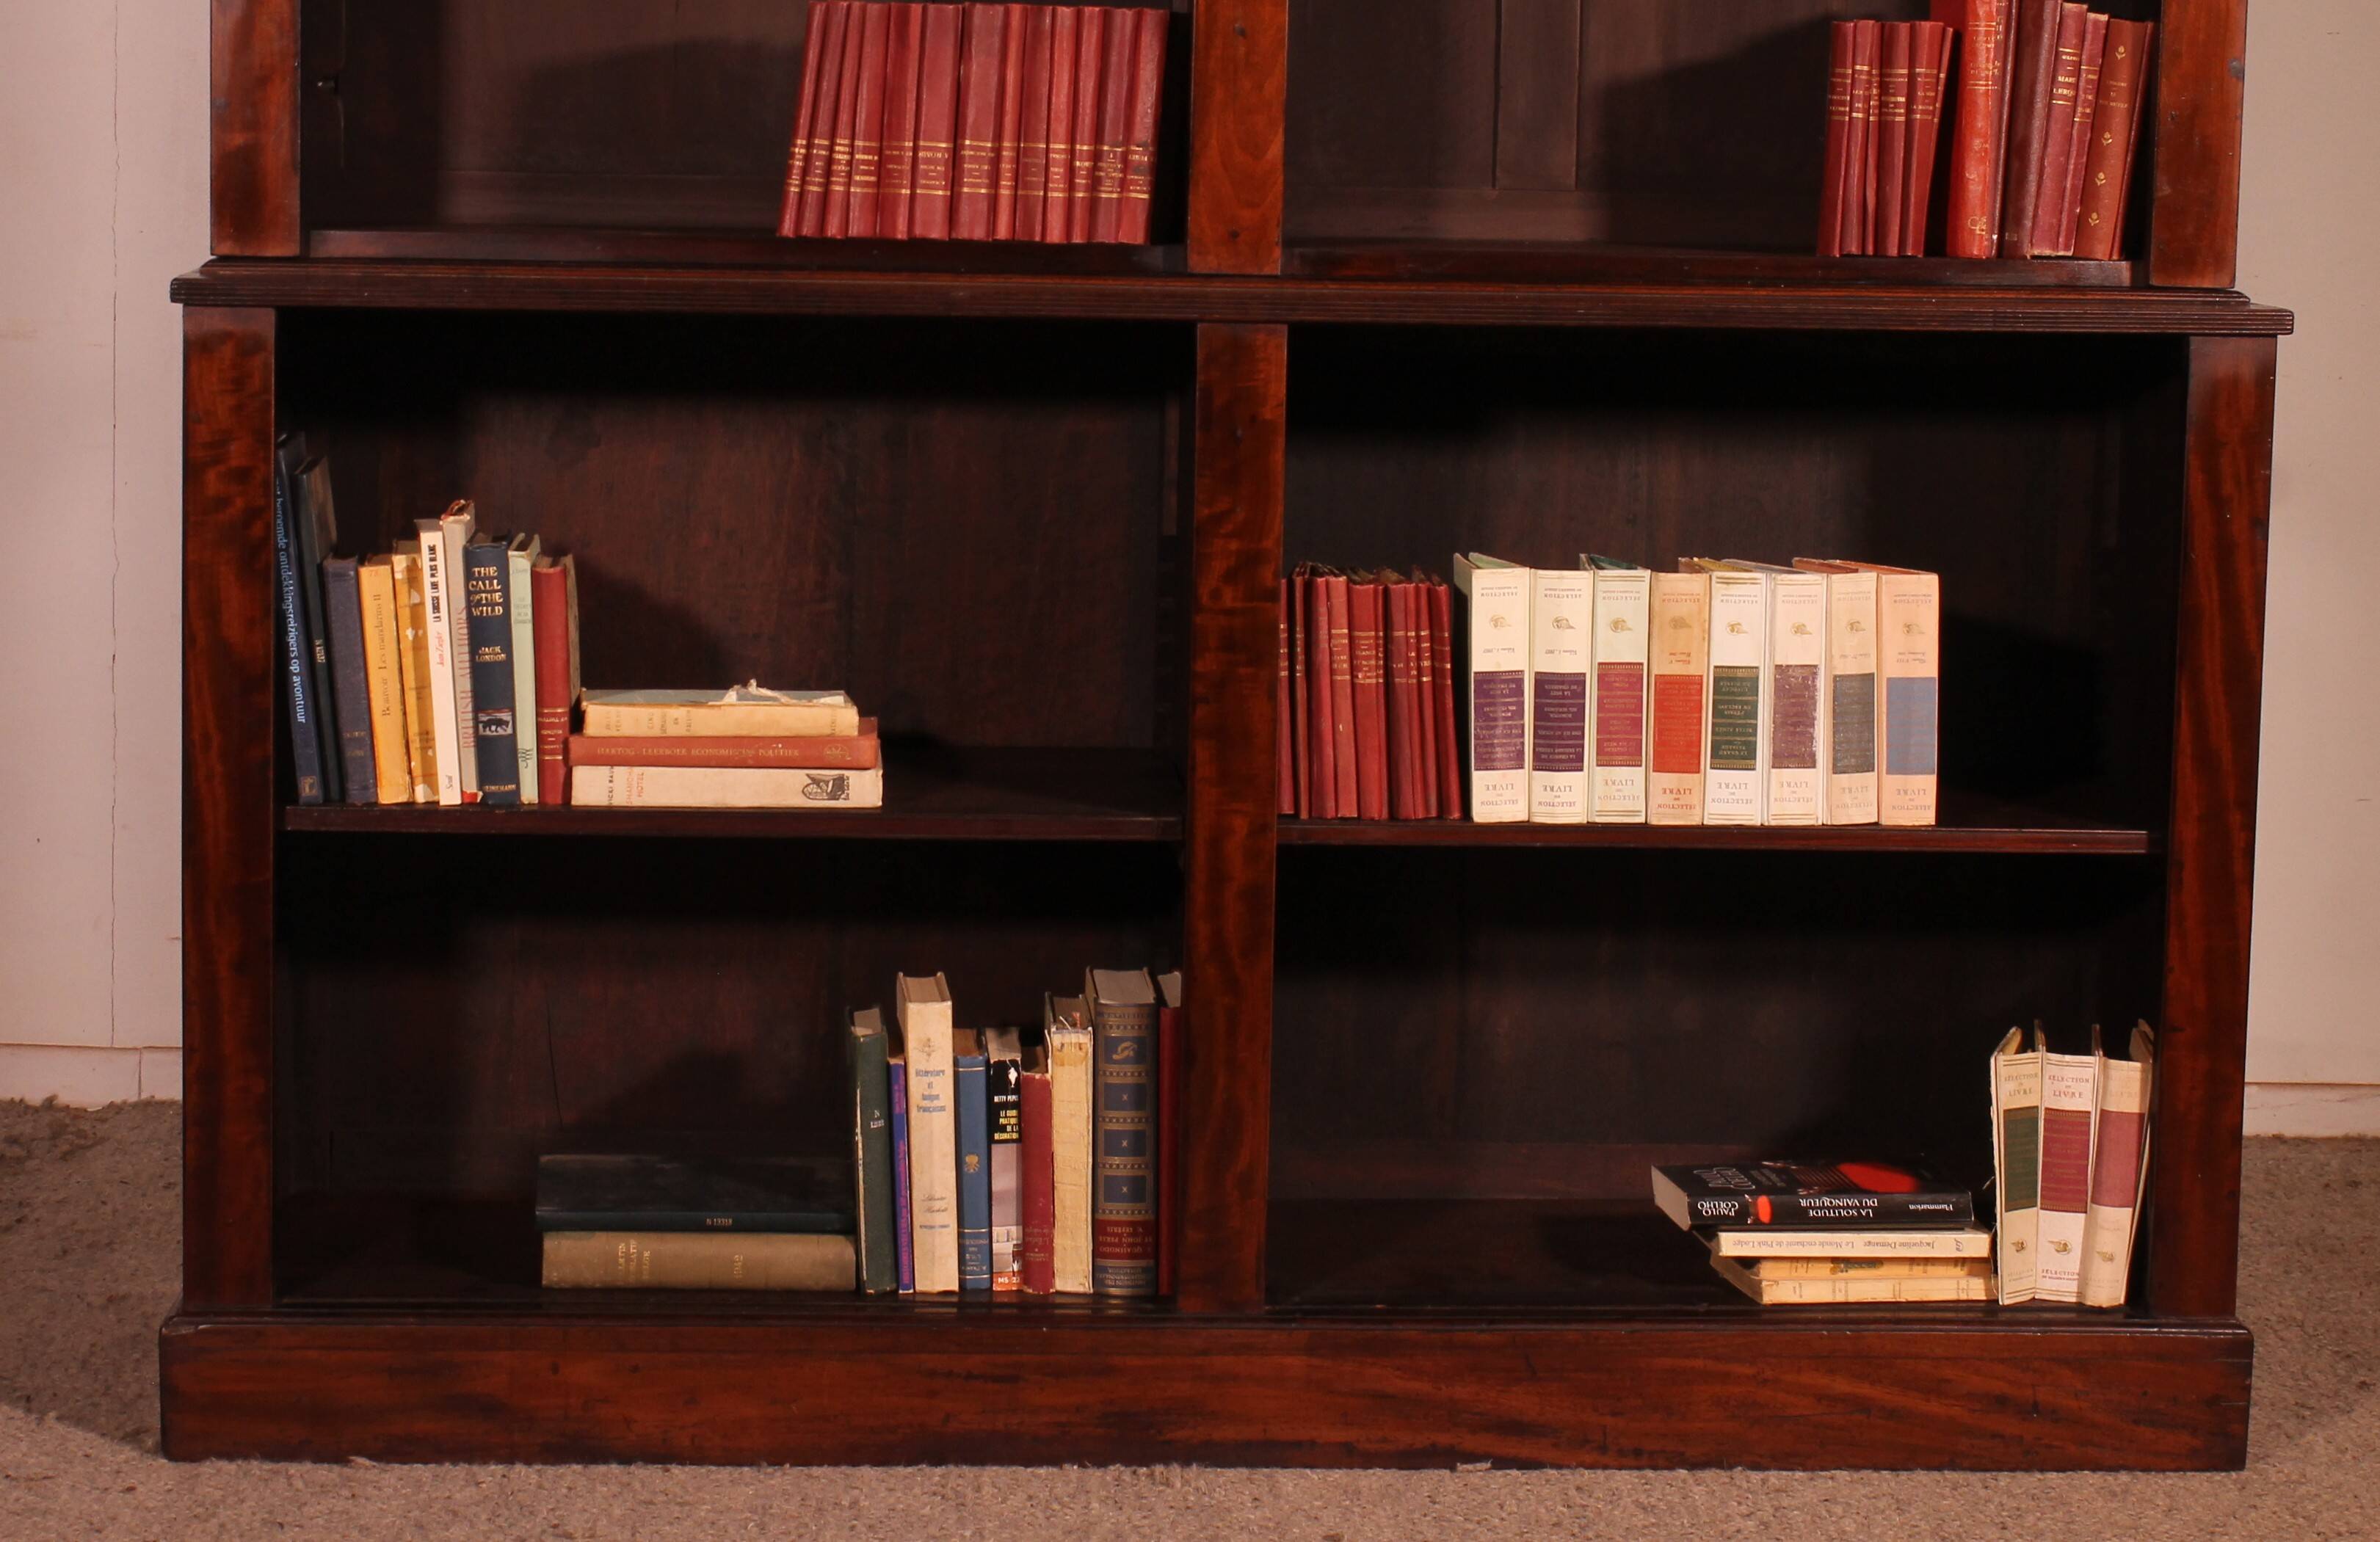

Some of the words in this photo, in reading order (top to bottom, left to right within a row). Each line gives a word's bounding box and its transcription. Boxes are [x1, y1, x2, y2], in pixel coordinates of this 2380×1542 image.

[427, 545, 438, 562] BLANC
[429, 564, 439, 578] PLUS
[472, 566, 498, 578] THE
[468, 579, 501, 591] CALL
[480, 592, 504, 603] THE
[472, 605, 504, 617] WILD
[479, 645, 501, 654] JACK
[476, 654, 507, 663] LONDON
[289, 660, 301, 677] op
[292, 676, 306, 724] avontuur
[636, 772, 645, 797] HOTEL
[1484, 783, 1514, 791] LIVRE
[1602, 779, 1634, 787] LIVRE
[1542, 785, 1573, 793] LIVRE
[2008, 1087, 2032, 1097] LIVRE
[2053, 1090, 2083, 1099] LIVRE
[1697, 1201, 1739, 1210] COELHO
[1799, 1197, 1860, 1207] VAINQUEUR
[1862, 1199, 1878, 1207] DU
[1702, 1208, 1735, 1217] PAULO
[1807, 1209, 1858, 1218] SOLITUDE
[1860, 1209, 1873, 1218] LA
[1733, 1239, 1755, 1248] Lodge
[1757, 1240, 1774, 1248] Pink
[1775, 1240, 1784, 1248] de
[1785, 1240, 1817, 1248] enchanté
[1818, 1240, 1843, 1248] Monde
[1863, 1240, 1897, 1249] Demange
[1898, 1240, 1935, 1249] Jacqueline
